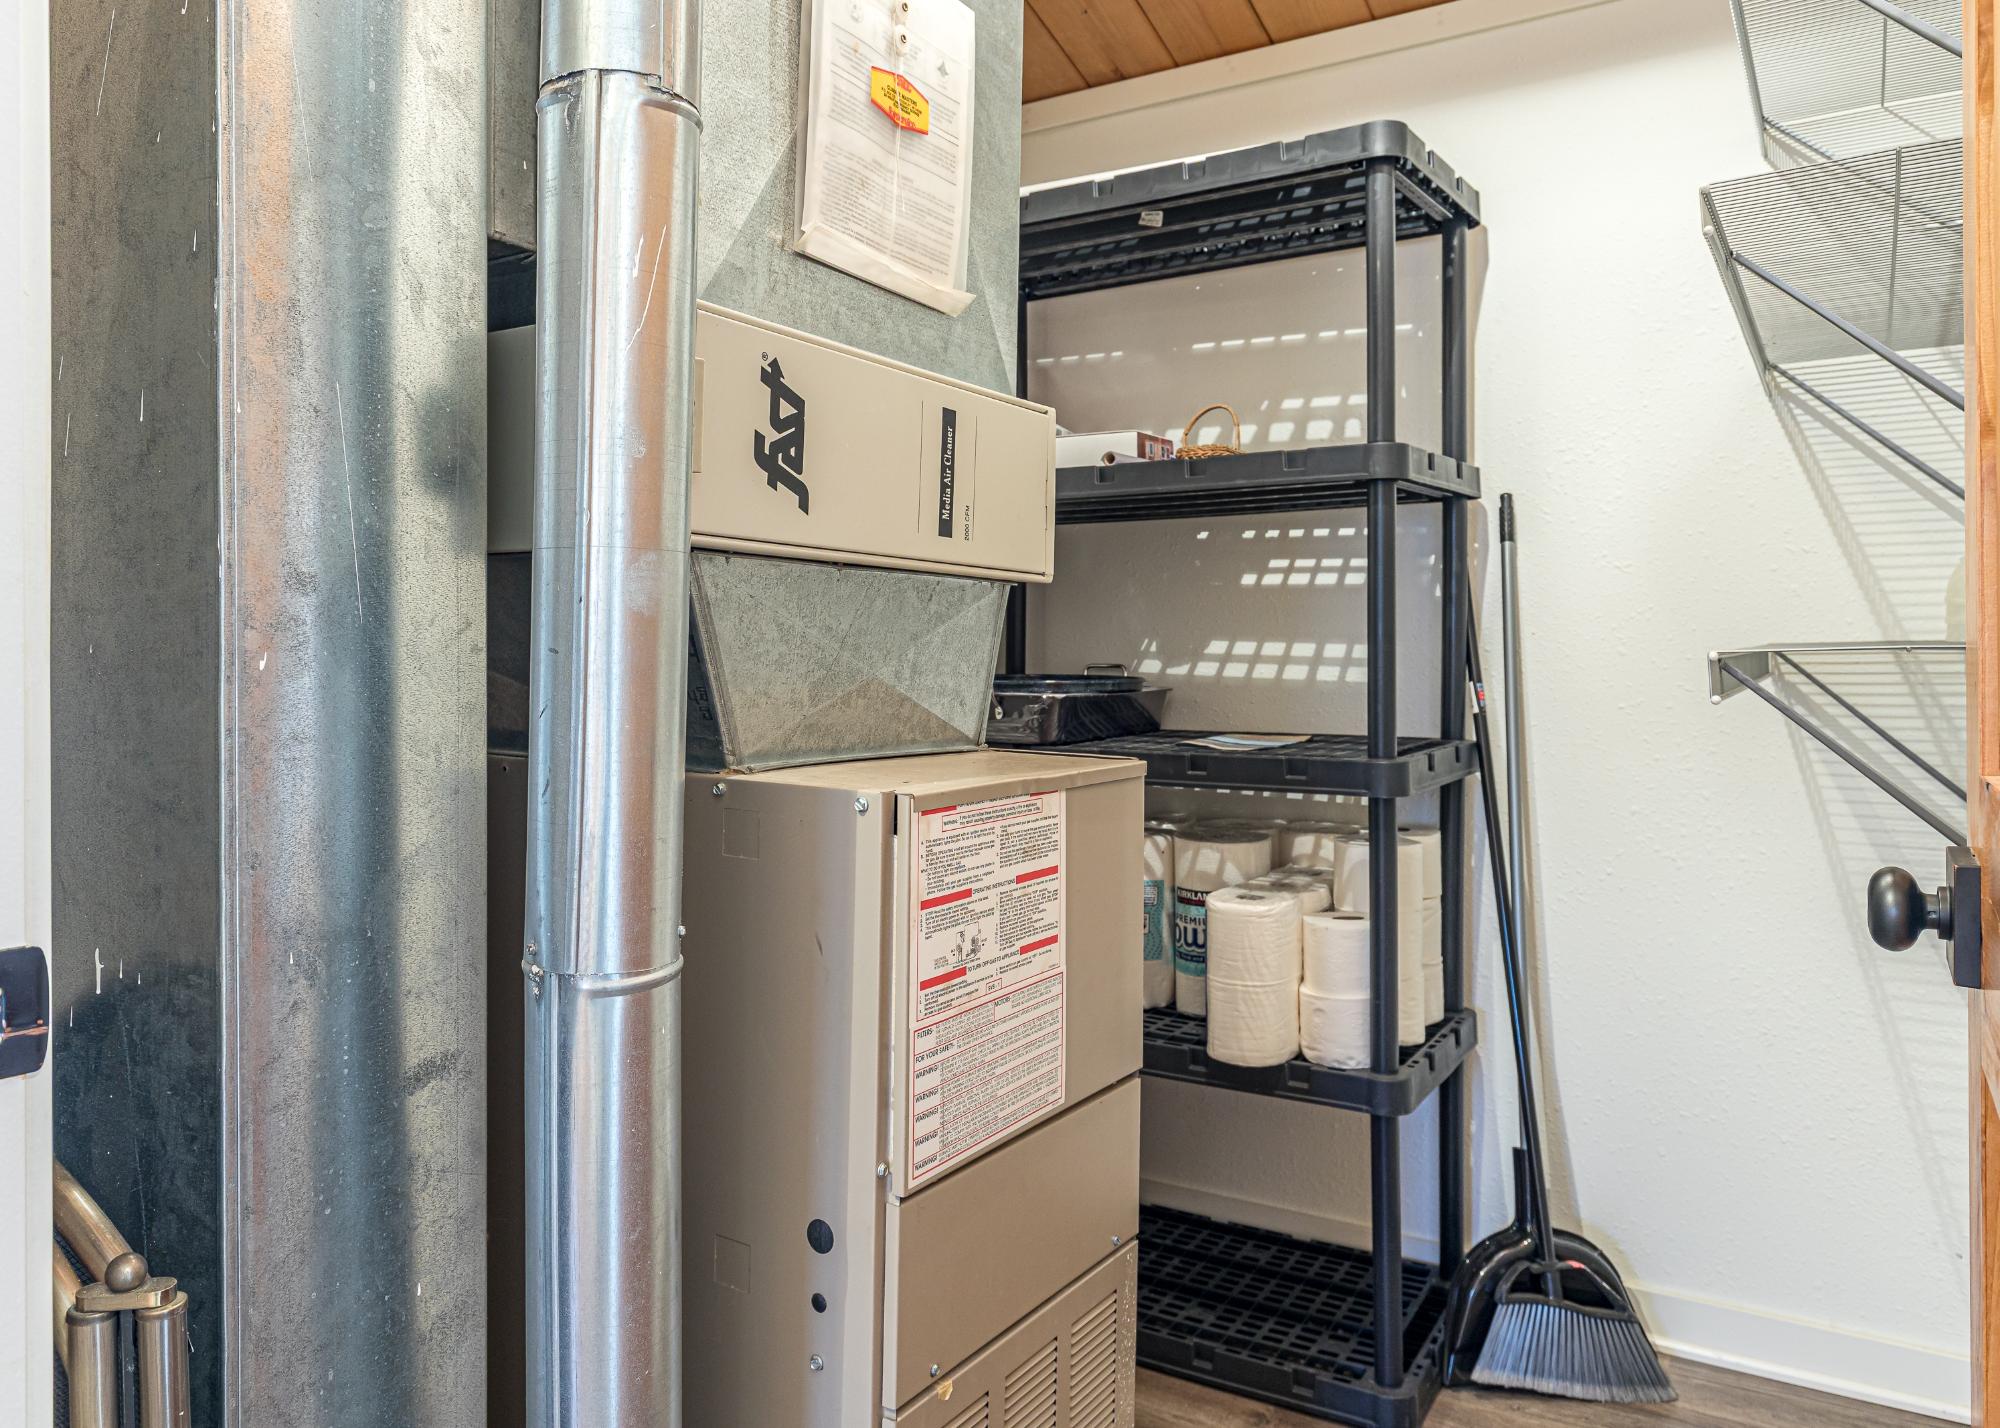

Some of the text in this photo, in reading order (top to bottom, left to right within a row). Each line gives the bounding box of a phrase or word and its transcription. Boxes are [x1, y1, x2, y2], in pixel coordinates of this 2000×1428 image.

[942, 426, 953, 520] Media Air Cleaner
[1177, 890, 1208, 900] KIRKLAN
[916, 1054, 925, 1063] FOR
[926, 1049, 939, 1059] YOUR
